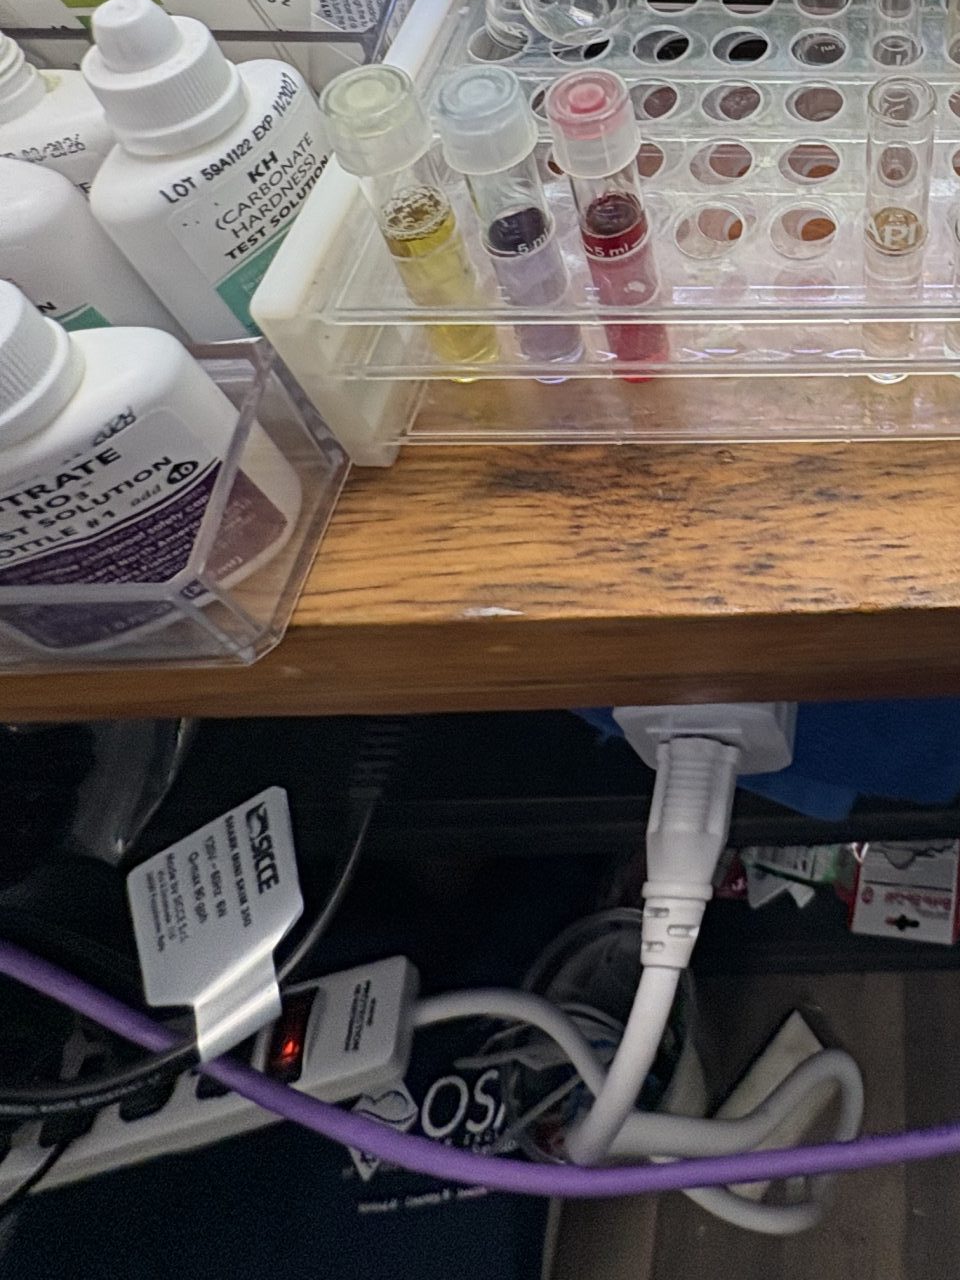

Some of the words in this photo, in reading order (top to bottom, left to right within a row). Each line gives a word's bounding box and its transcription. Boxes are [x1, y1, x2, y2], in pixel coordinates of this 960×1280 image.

[159, 177, 197, 204] LOT
[252, 115, 273, 141] EXP
[215, 132, 313, 230] (CARBONATE
[231, 154, 317, 238] HARDNESS)
[247, 151, 278, 183] KH
[224, 226, 267, 260] TEST
[271, 155, 329, 228] SOLUTION
[38, 456, 173, 528] SOLUTION
[130, 484, 162, 507] add
[251, 833, 280, 895] SICCE
